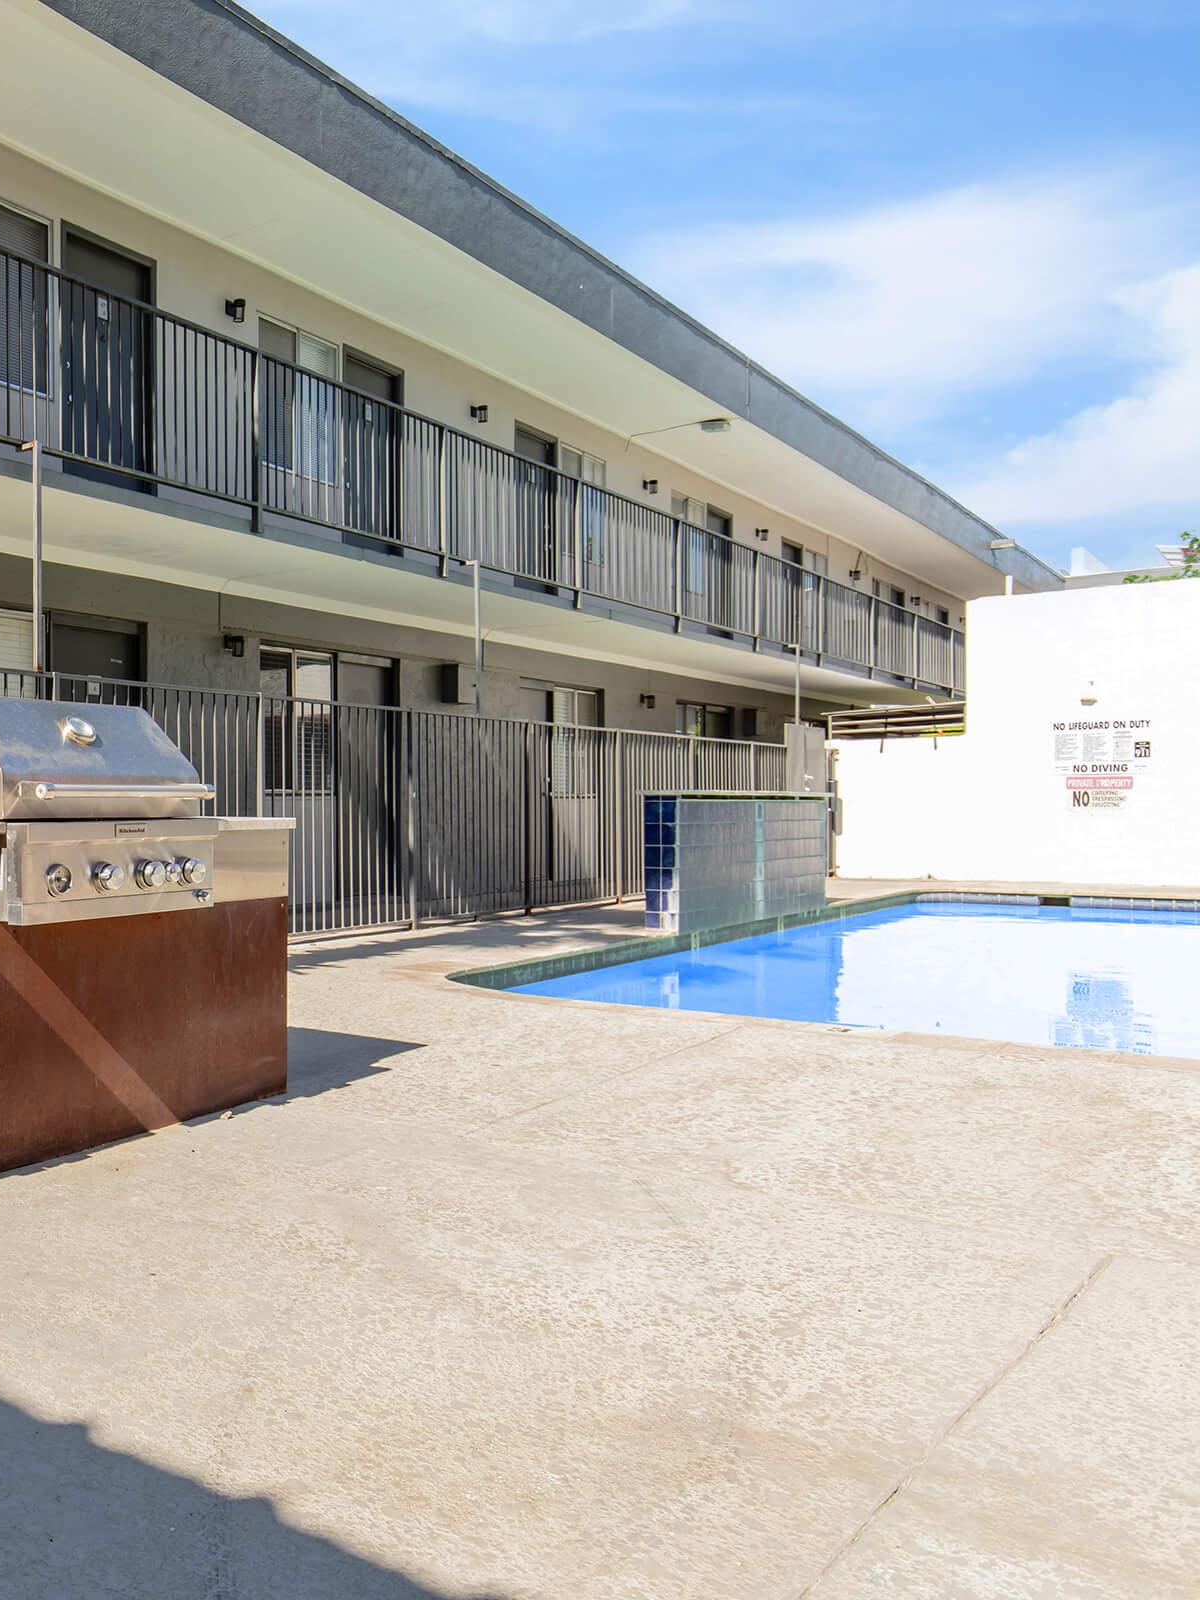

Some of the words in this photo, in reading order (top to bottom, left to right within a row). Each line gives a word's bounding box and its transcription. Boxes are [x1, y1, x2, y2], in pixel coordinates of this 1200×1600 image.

[1068, 722, 1110, 730] LIFEGUARD
[1130, 720, 1150, 728] DUTY
[1135, 748, 1149, 757] 911
[1092, 764, 1128, 772] DIVING
[1073, 791, 1090, 807] NO
